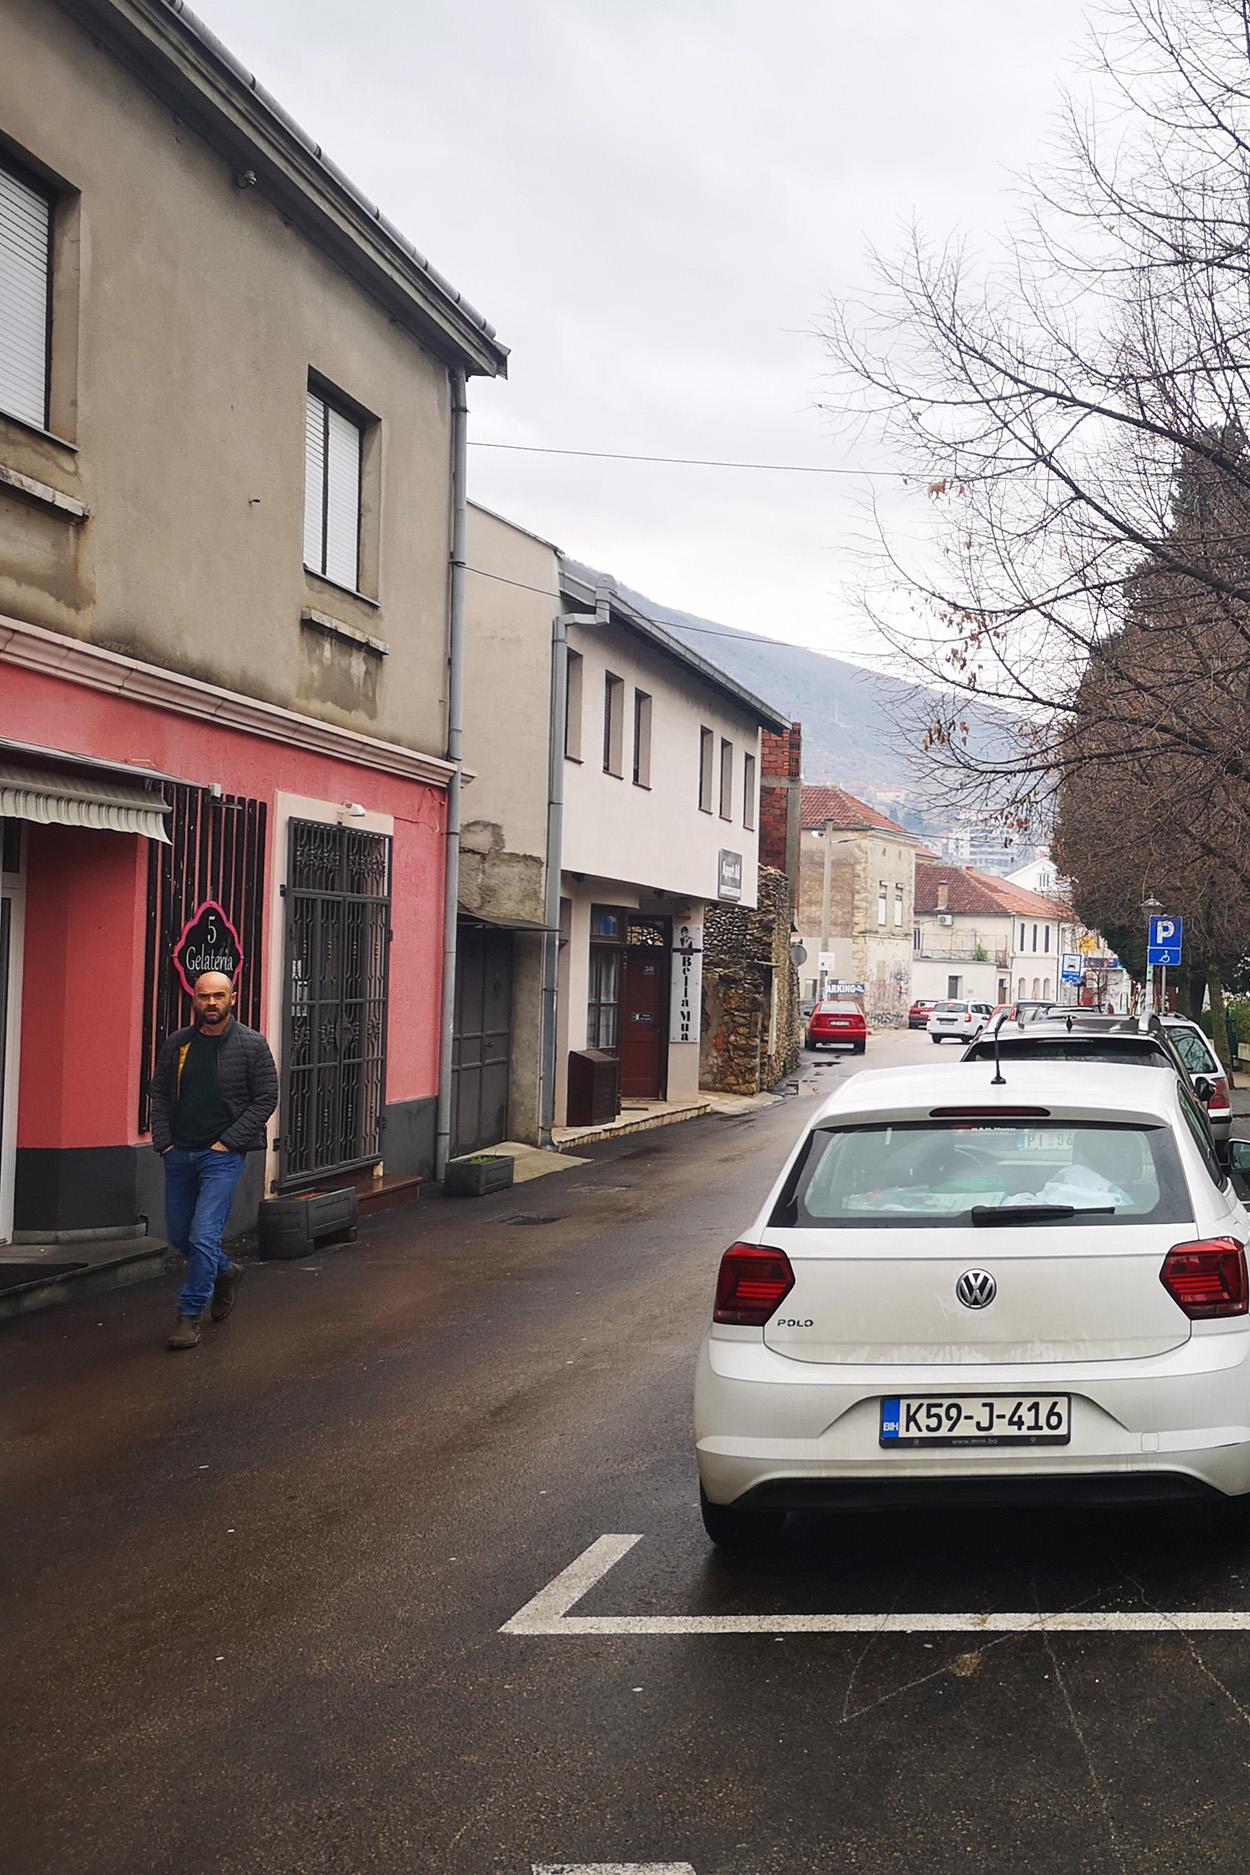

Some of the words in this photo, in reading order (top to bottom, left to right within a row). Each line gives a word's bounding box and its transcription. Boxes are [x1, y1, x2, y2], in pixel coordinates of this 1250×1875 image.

[207, 915, 217, 944] 5
[1156, 920, 1175, 944] P
[185, 944, 234, 971] Gelateria
[826, 984, 856, 994] ARKING
[777, 1319, 814, 1328] POLO
[905, 1401, 1063, 1432] K59-J-416
